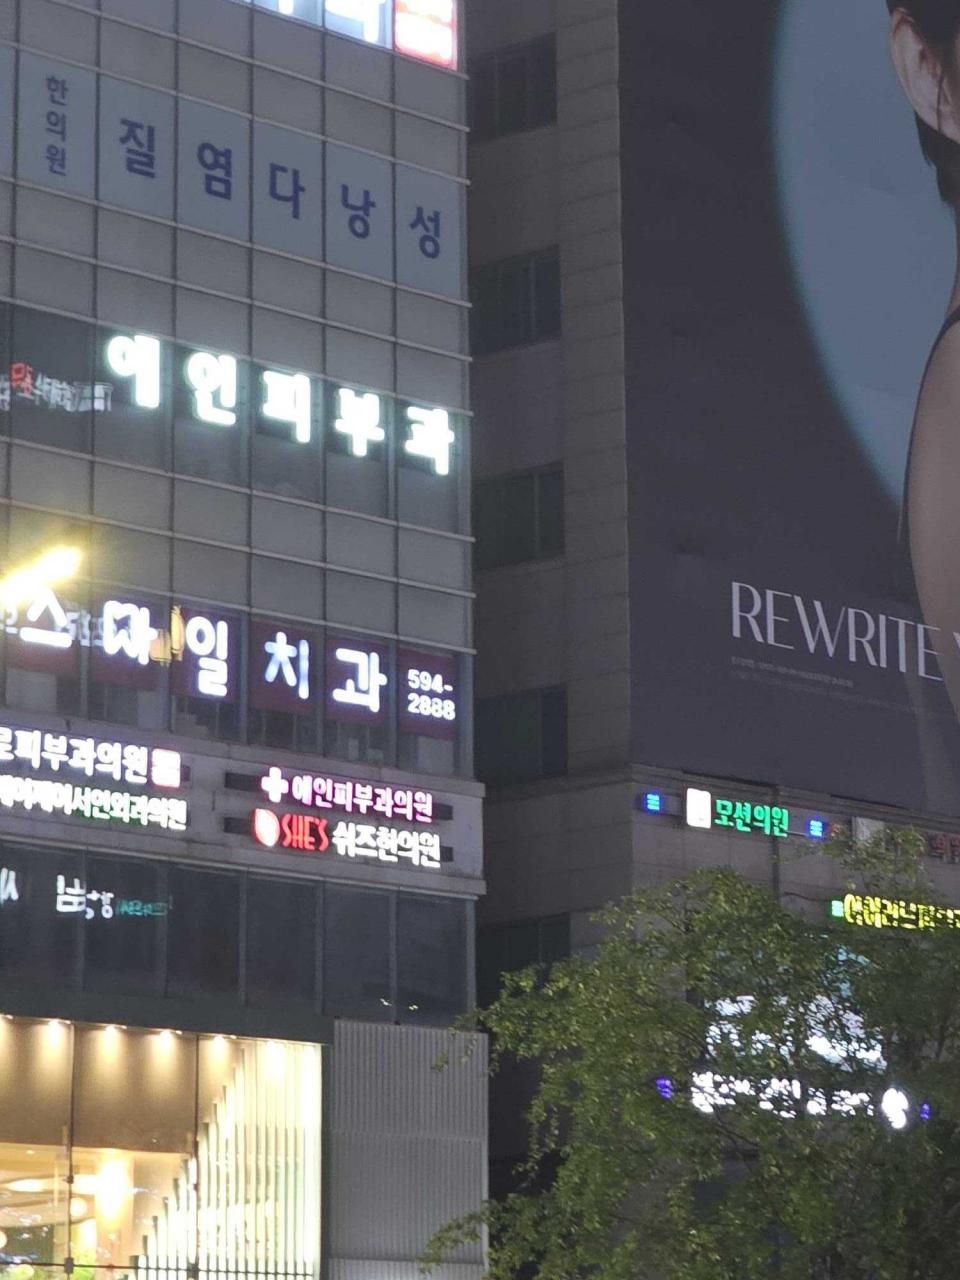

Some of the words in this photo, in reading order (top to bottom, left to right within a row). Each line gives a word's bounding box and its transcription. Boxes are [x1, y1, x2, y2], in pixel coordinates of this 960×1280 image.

[45, 75, 68, 176] 한의원
[731, 581, 944, 682] REWRITE
[407, 668, 453, 694] 594-
[714, 798, 789, 838] 모션의원
[332, 821, 441, 868] 쉬즈한의원
